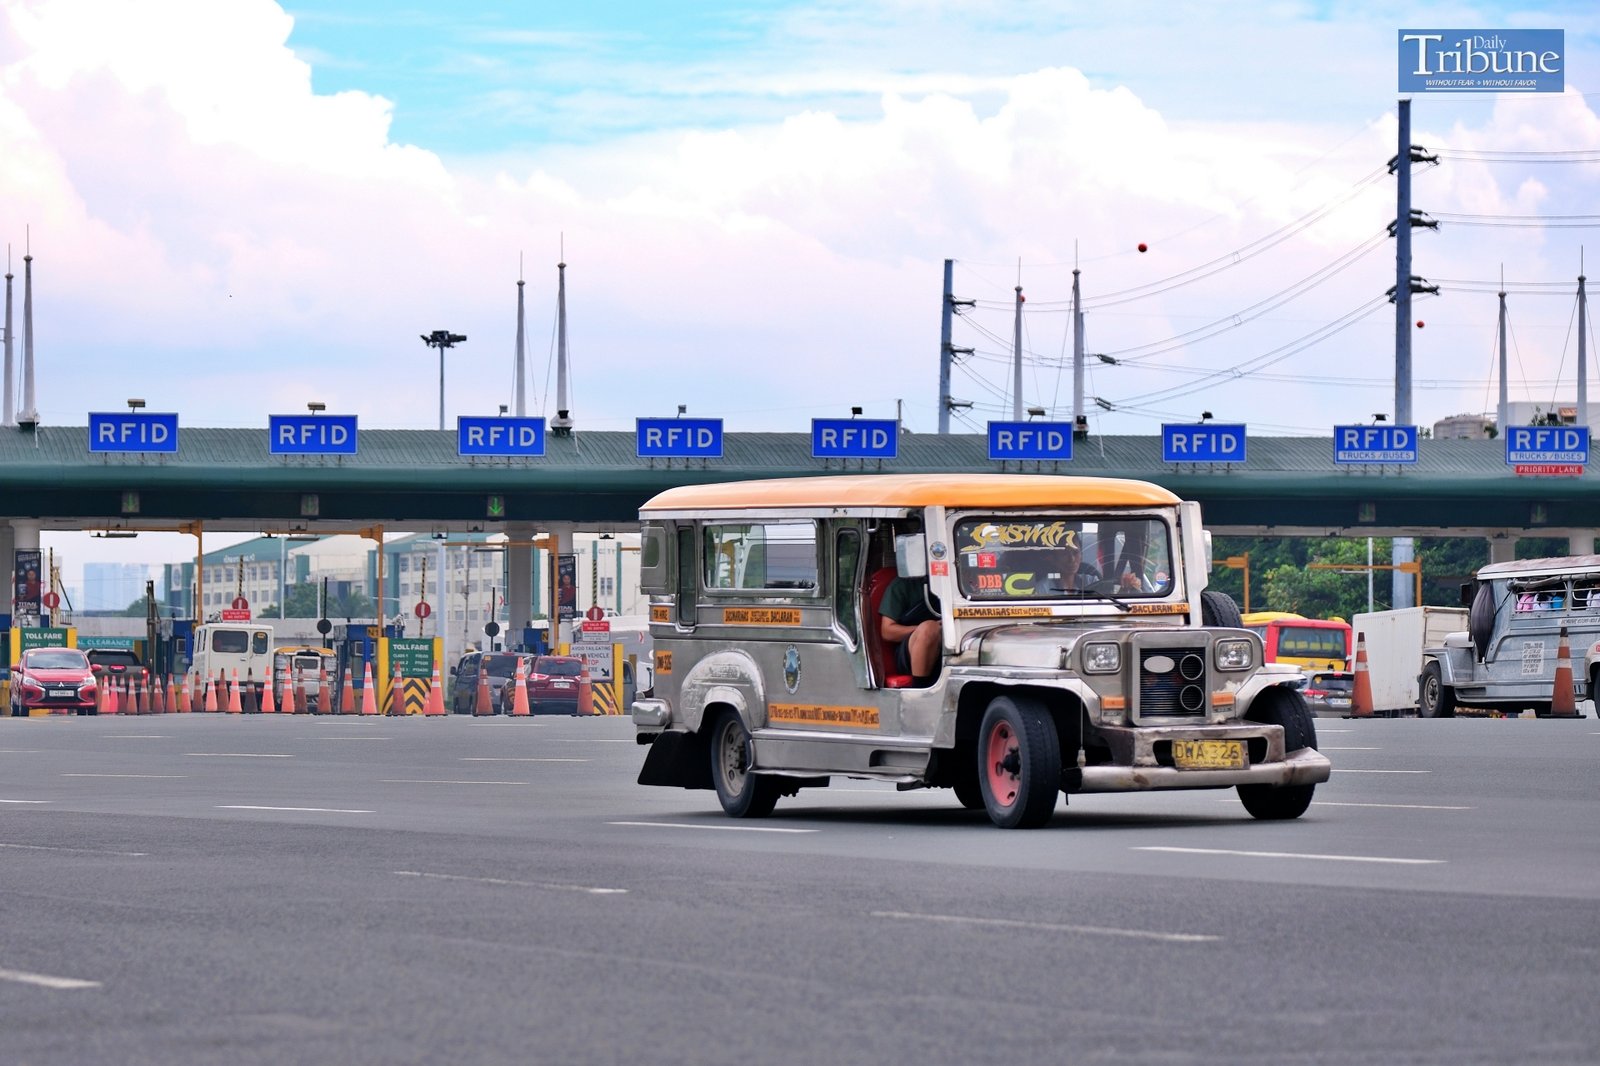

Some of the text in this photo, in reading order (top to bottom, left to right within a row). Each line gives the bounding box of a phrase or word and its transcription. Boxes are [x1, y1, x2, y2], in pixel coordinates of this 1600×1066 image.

[99, 423, 168, 443] RFID
[280, 425, 347, 445] RFID
[468, 427, 535, 446] RFID
[646, 428, 713, 447] RFID
[821, 429, 888, 448] RFID
[997, 431, 1063, 450] RFID
[1172, 433, 1236, 452] RFID
[1344, 430, 1408, 449] RFID
[1515, 430, 1579, 449] RFID
[1515, 452, 1547, 460] TRUCKS
[978, 573, 1003, 589] DBB
[1004, 573, 1036, 596] C
[1132, 604, 1173, 613] BACLARAN
[24, 632, 63, 640] TOLL FARE
[392, 643, 429, 651] TOLL FARE
[1174, 742, 1205, 759] DWA
